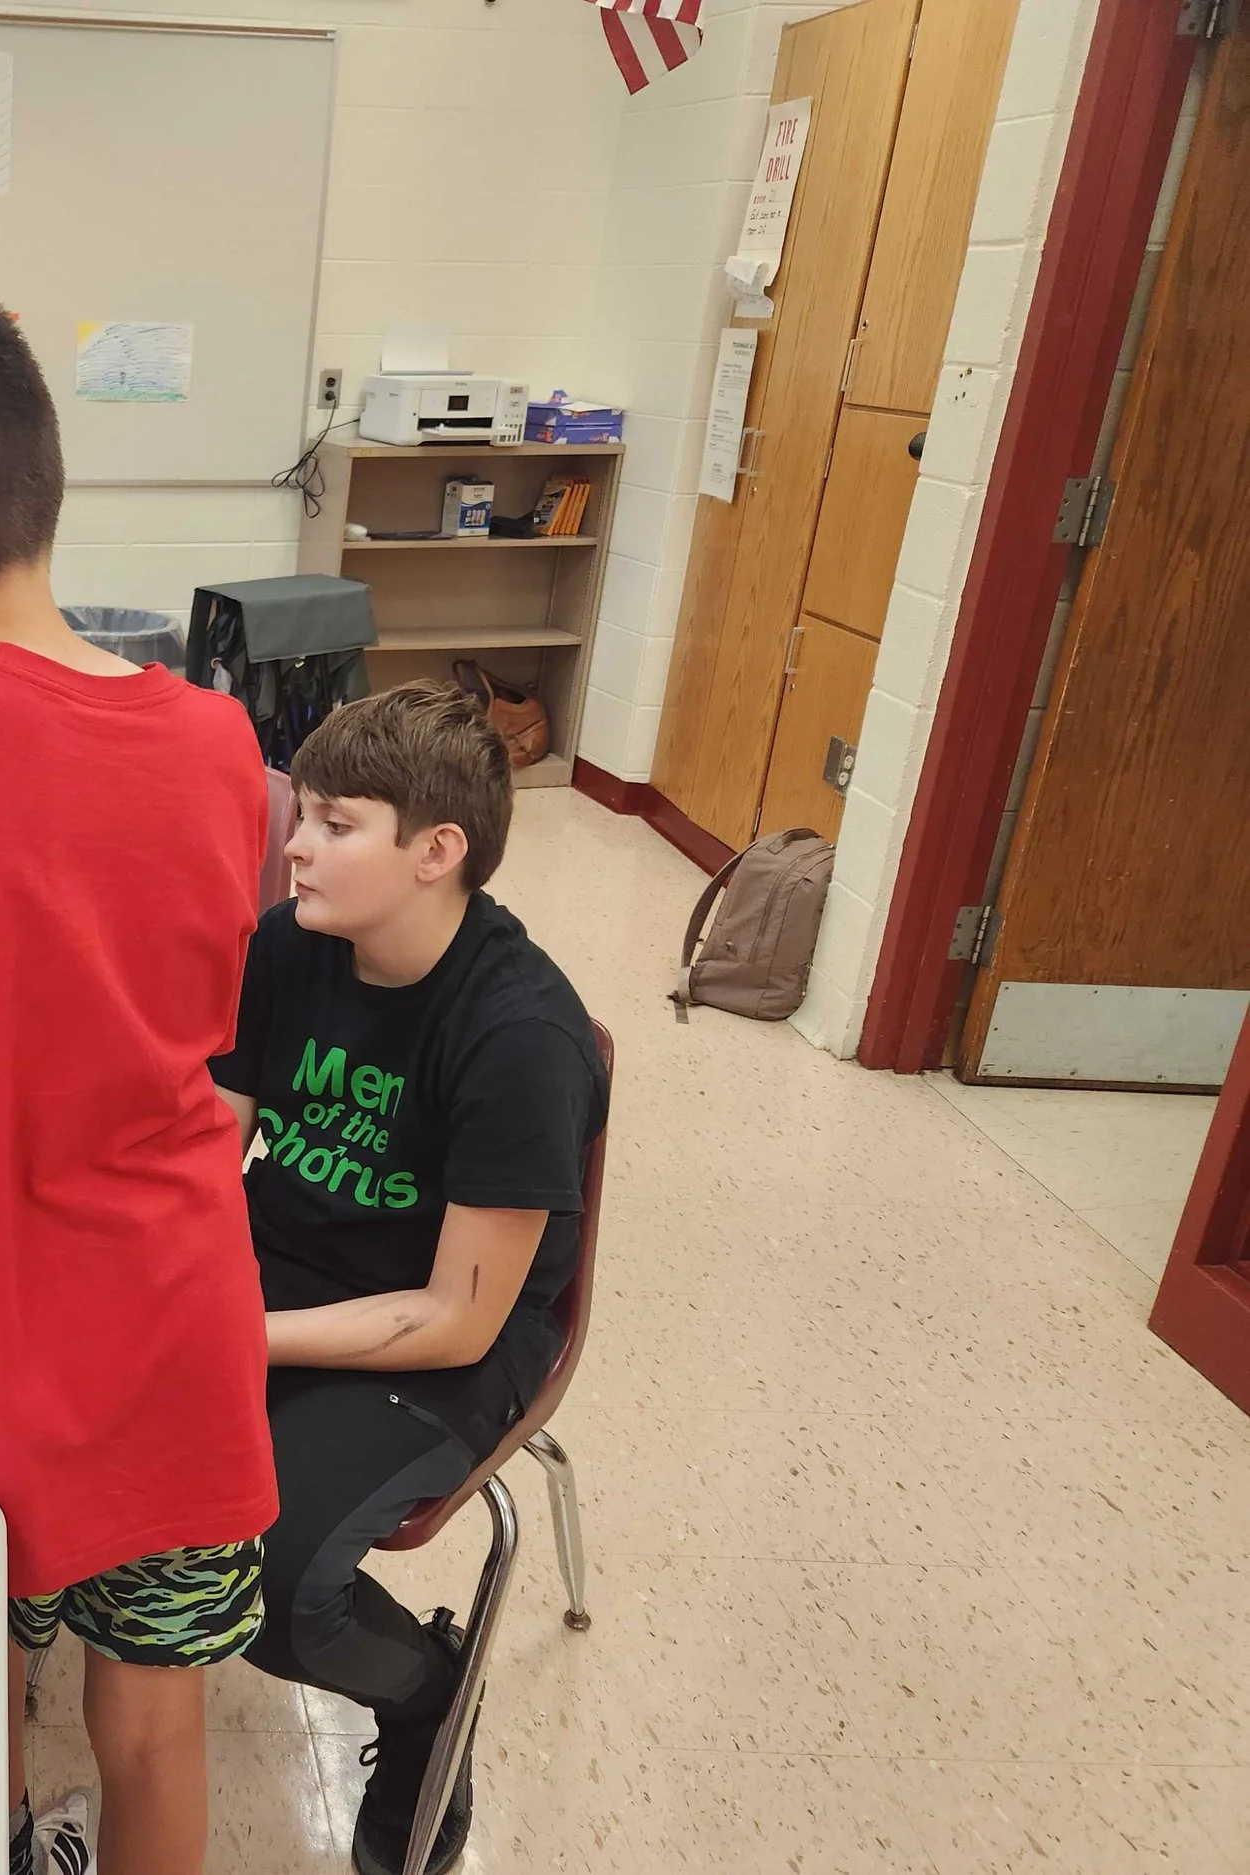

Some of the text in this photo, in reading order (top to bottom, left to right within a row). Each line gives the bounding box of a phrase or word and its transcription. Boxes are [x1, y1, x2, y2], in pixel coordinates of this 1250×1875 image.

[776, 118, 798, 147] FIRE
[766, 154, 791, 182] DRILL
[291, 1037, 406, 1119] Men
[302, 1102, 390, 1154] of the
